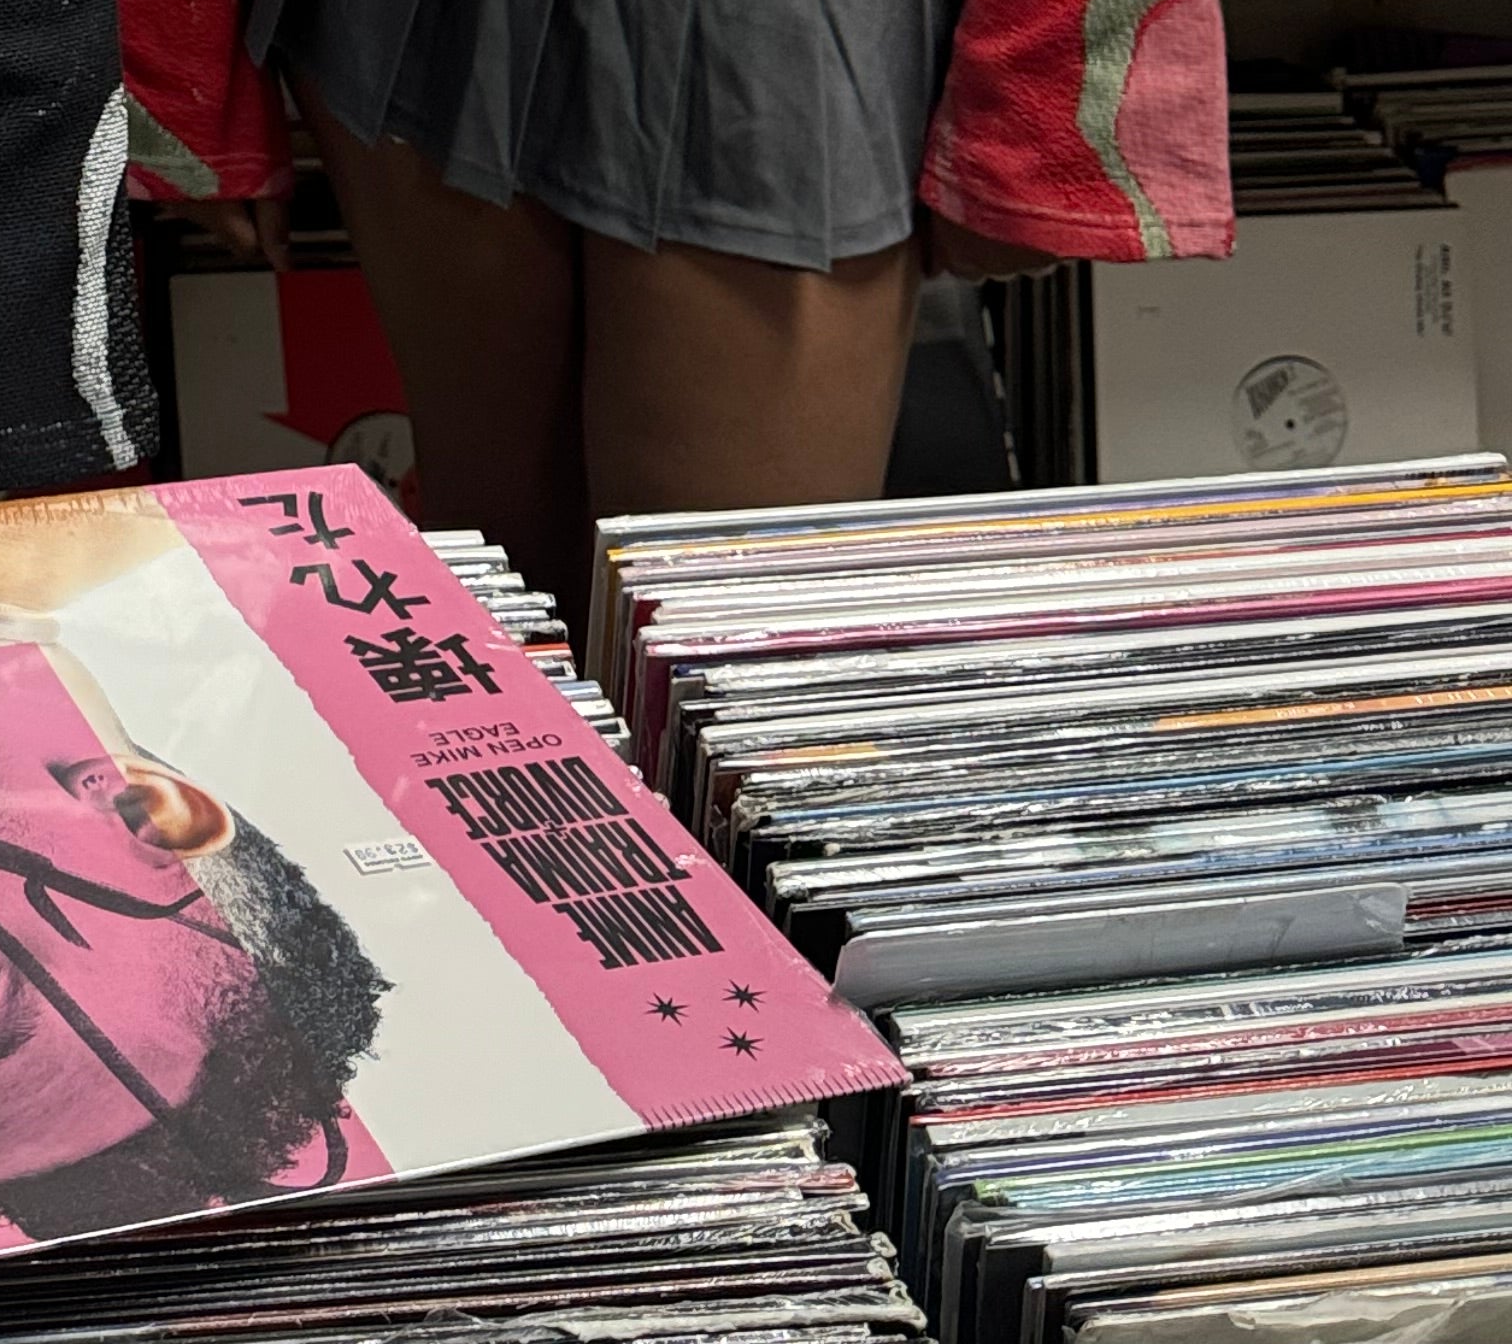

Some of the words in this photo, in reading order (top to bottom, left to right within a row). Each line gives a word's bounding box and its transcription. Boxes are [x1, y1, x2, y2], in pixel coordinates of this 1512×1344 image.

[409, 744, 482, 768] MIKE
[427, 721, 520, 748] EAGLE
[487, 732, 563, 758] OPEN
[424, 756, 629, 841] DIVORCE
[481, 817, 693, 904] TRAUMA
[551, 884, 725, 971] ANIME
